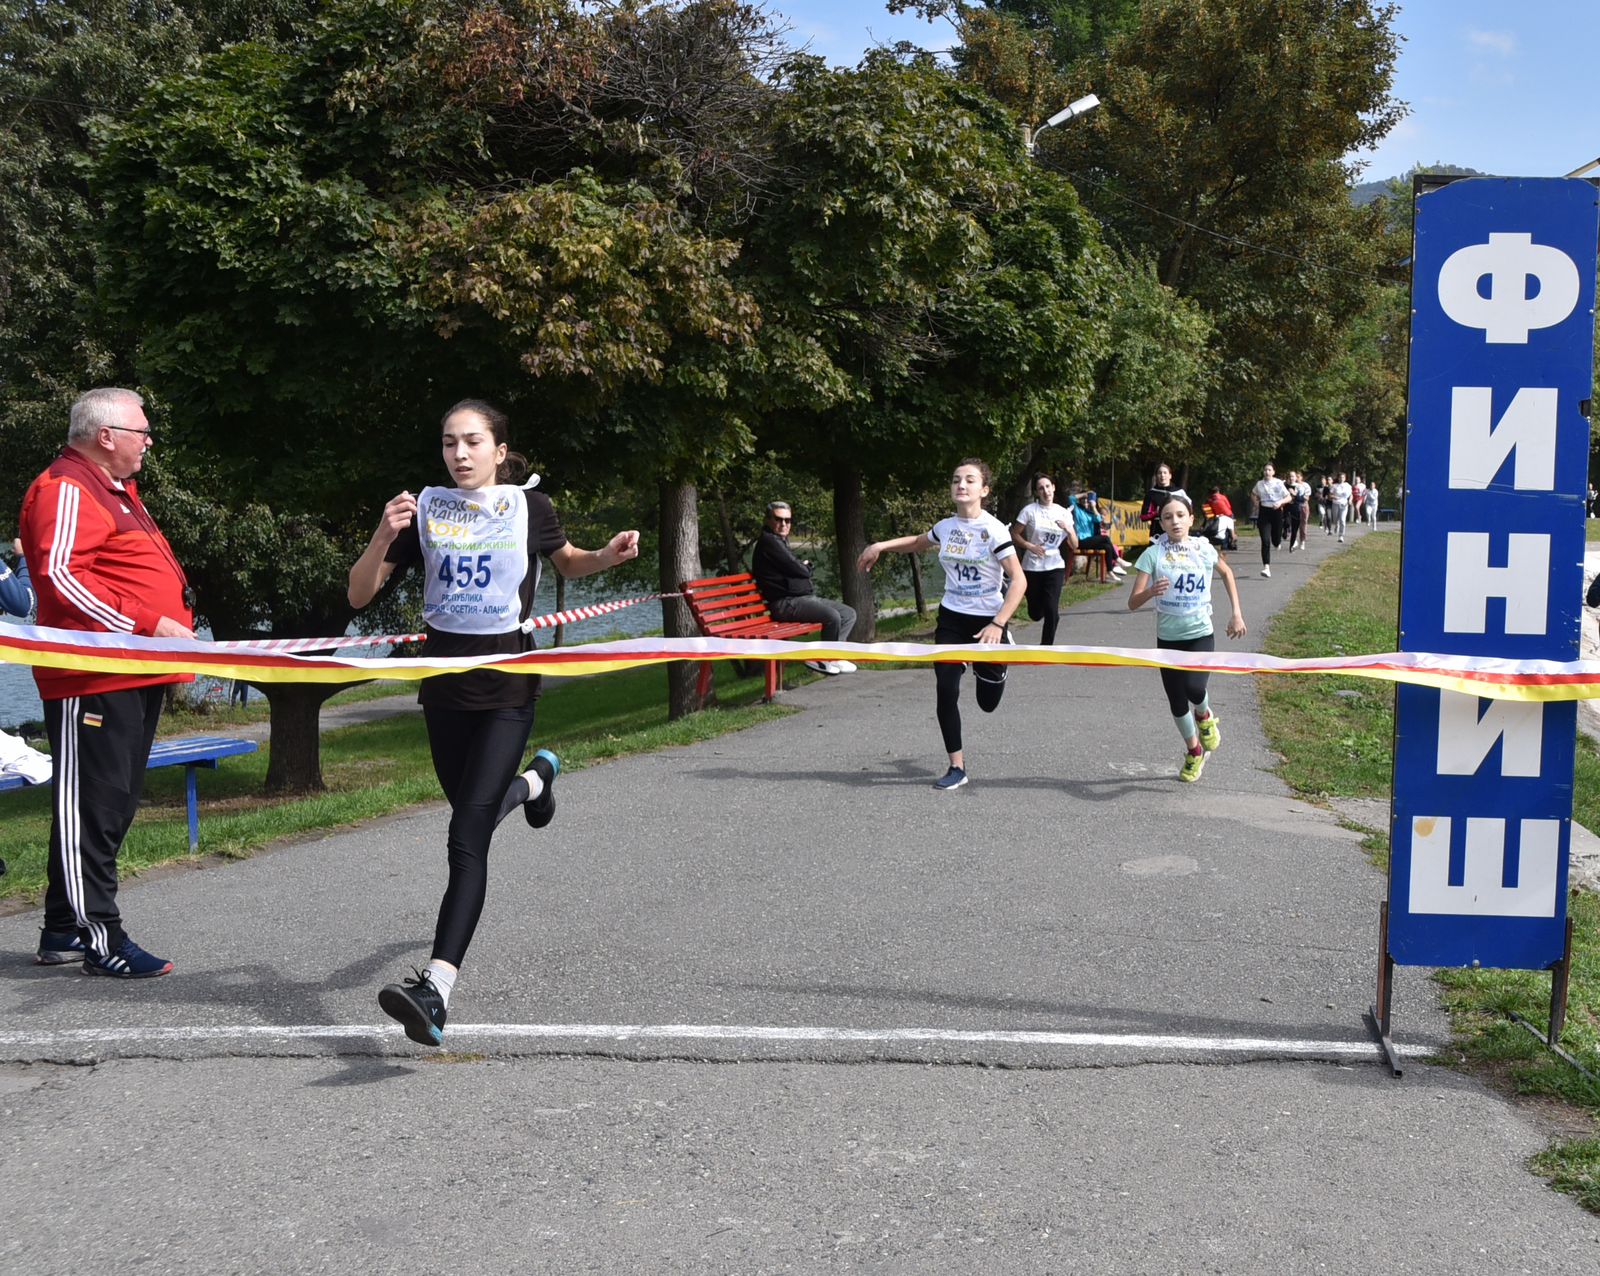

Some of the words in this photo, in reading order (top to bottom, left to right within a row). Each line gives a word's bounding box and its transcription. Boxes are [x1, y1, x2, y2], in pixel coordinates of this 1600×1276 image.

[430, 496, 467, 512] КРОСС
[427, 504, 479, 524] НАЦИИ
[945, 543, 967, 555] 2021
[438, 554, 492, 588] 455
[954, 562, 981, 581] 142
[1408, 232, 1580, 918] ФИНИШ
[1174, 573, 1206, 594] 454
[450, 604, 478, 614] ОСЕТИЯ
